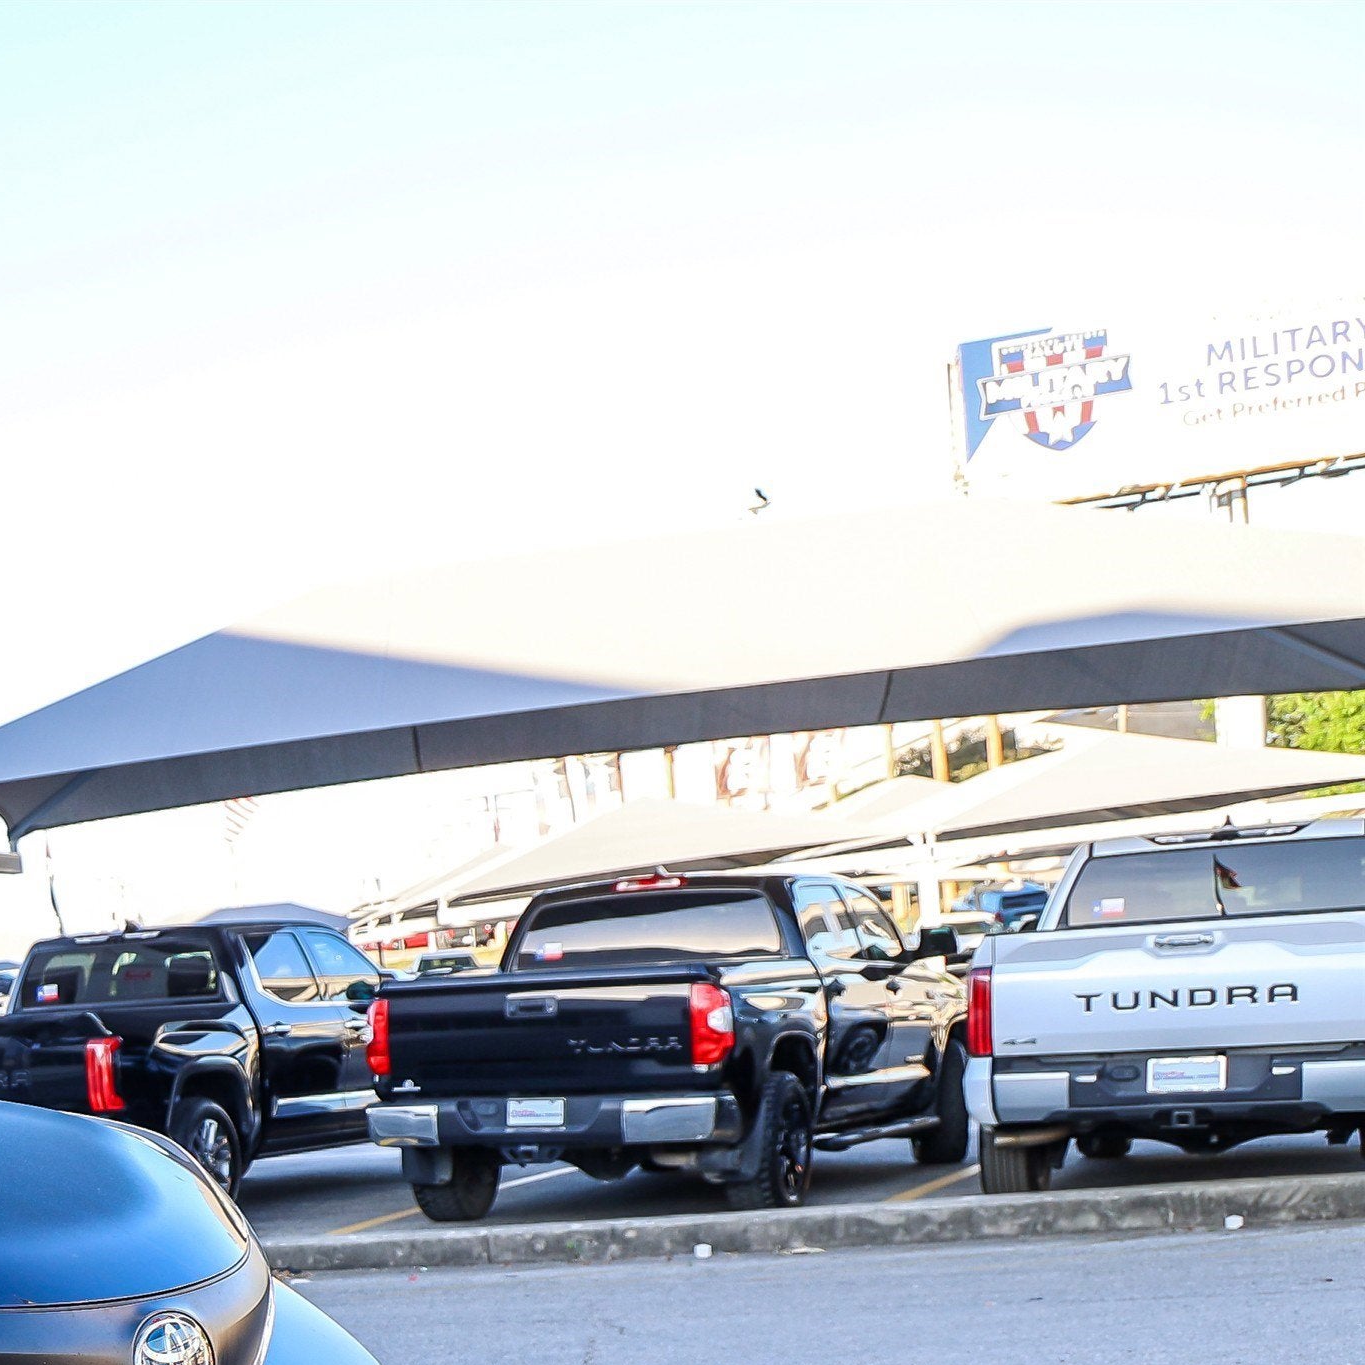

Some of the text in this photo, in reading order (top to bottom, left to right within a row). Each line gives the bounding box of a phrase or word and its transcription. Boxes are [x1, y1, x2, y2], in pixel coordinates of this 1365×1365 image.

[1159, 377, 1205, 406] 1st
[1183, 407, 1222, 426] Get
[1232, 384, 1347, 418] Preferred
[1074, 982, 1300, 1013] TUNDRA
